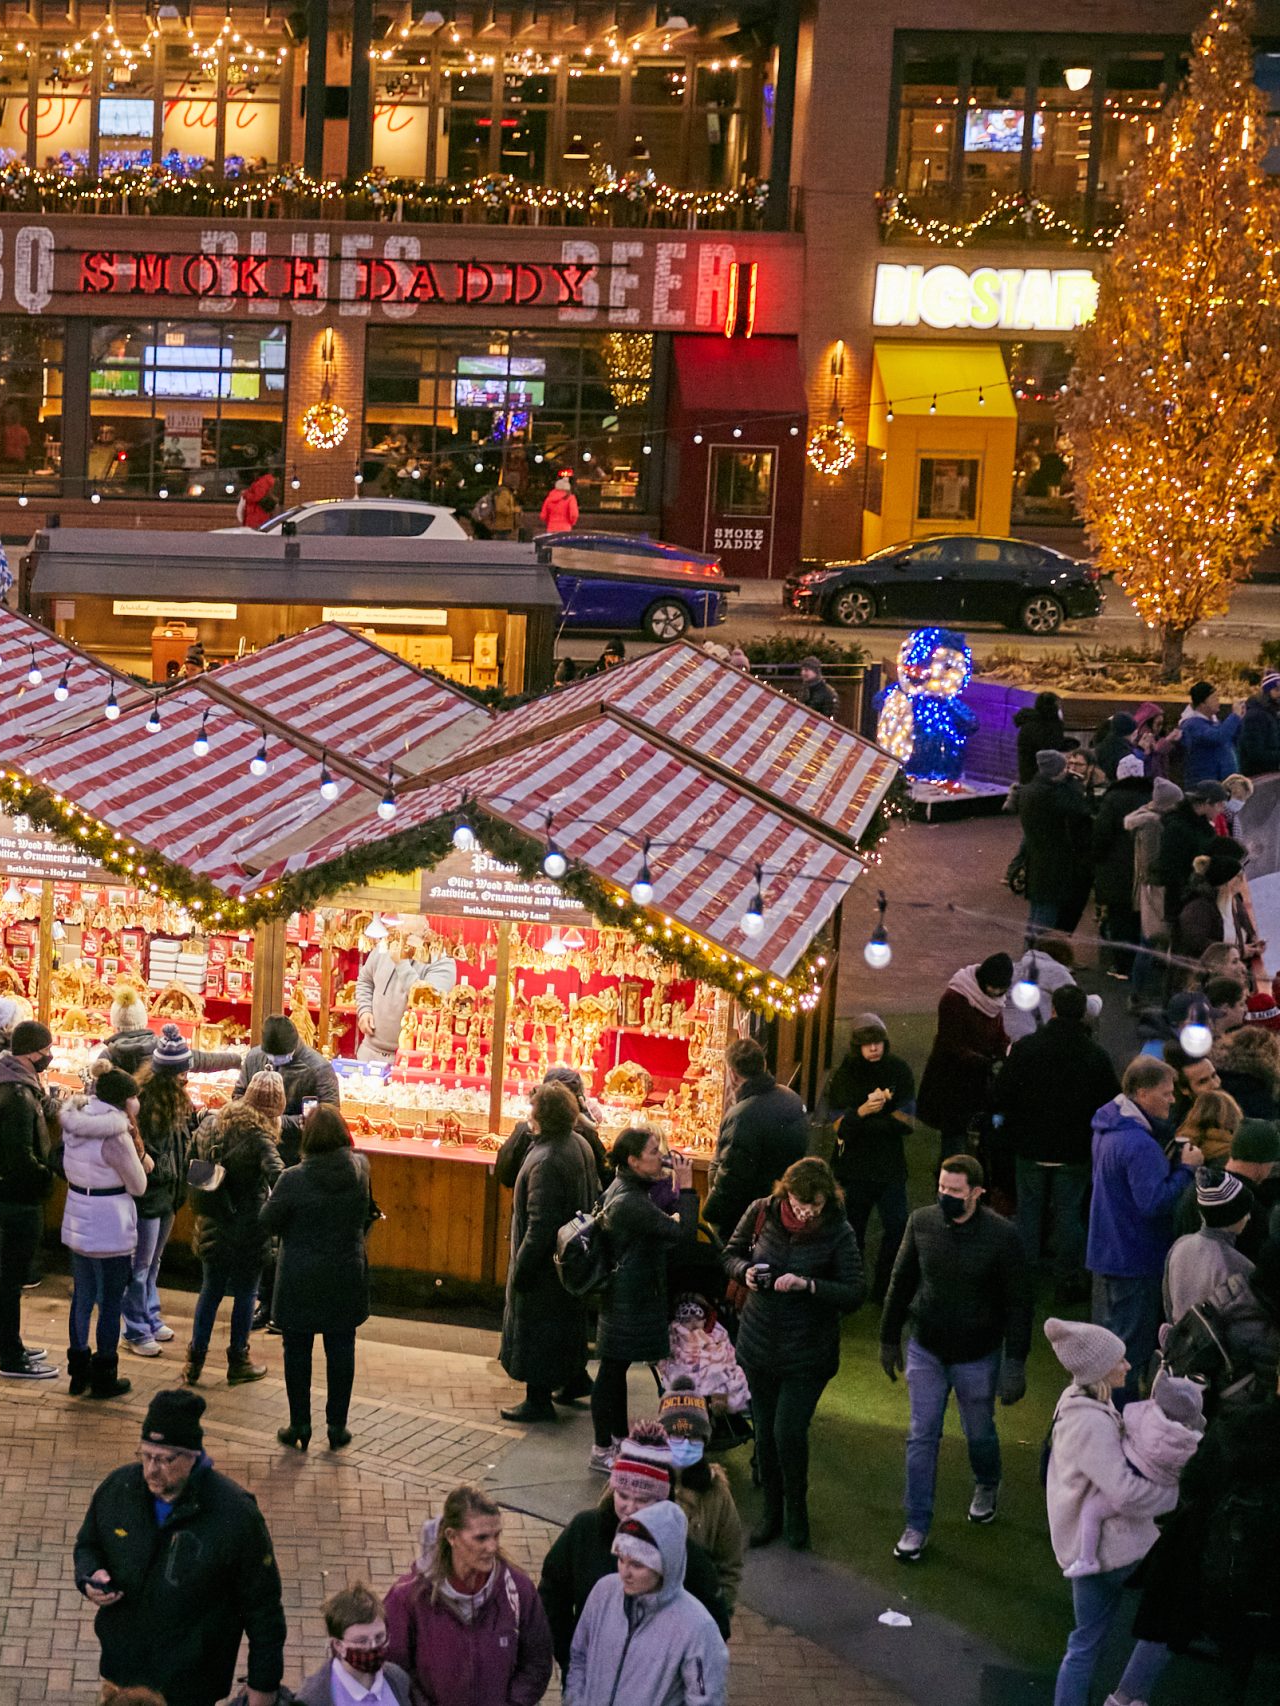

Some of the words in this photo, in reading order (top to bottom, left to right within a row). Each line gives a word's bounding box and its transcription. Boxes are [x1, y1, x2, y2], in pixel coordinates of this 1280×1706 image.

[83, 250, 320, 300] SMOKE
[363, 259, 595, 307] DADDY
[714, 528, 764, 539] SMOKE
[714, 539, 763, 550] DADDY
[18, 839, 43, 850] Wood
[23, 850, 70, 864] Ornaments
[72, 855, 87, 864] and
[7, 865, 44, 875] Bethlehem
[50, 868, 68, 879] Holy
[69, 869, 86, 878] Land
[448, 877, 473, 888] Olive
[475, 878, 502, 891] Wood
[429, 887, 479, 901] Nativities,
[481, 891, 533, 905] Ornaments
[534, 896, 550, 906] and
[463, 906, 504, 917] Bethlehem
[510, 910, 528, 921] Holy
[530, 911, 550, 921] Land
